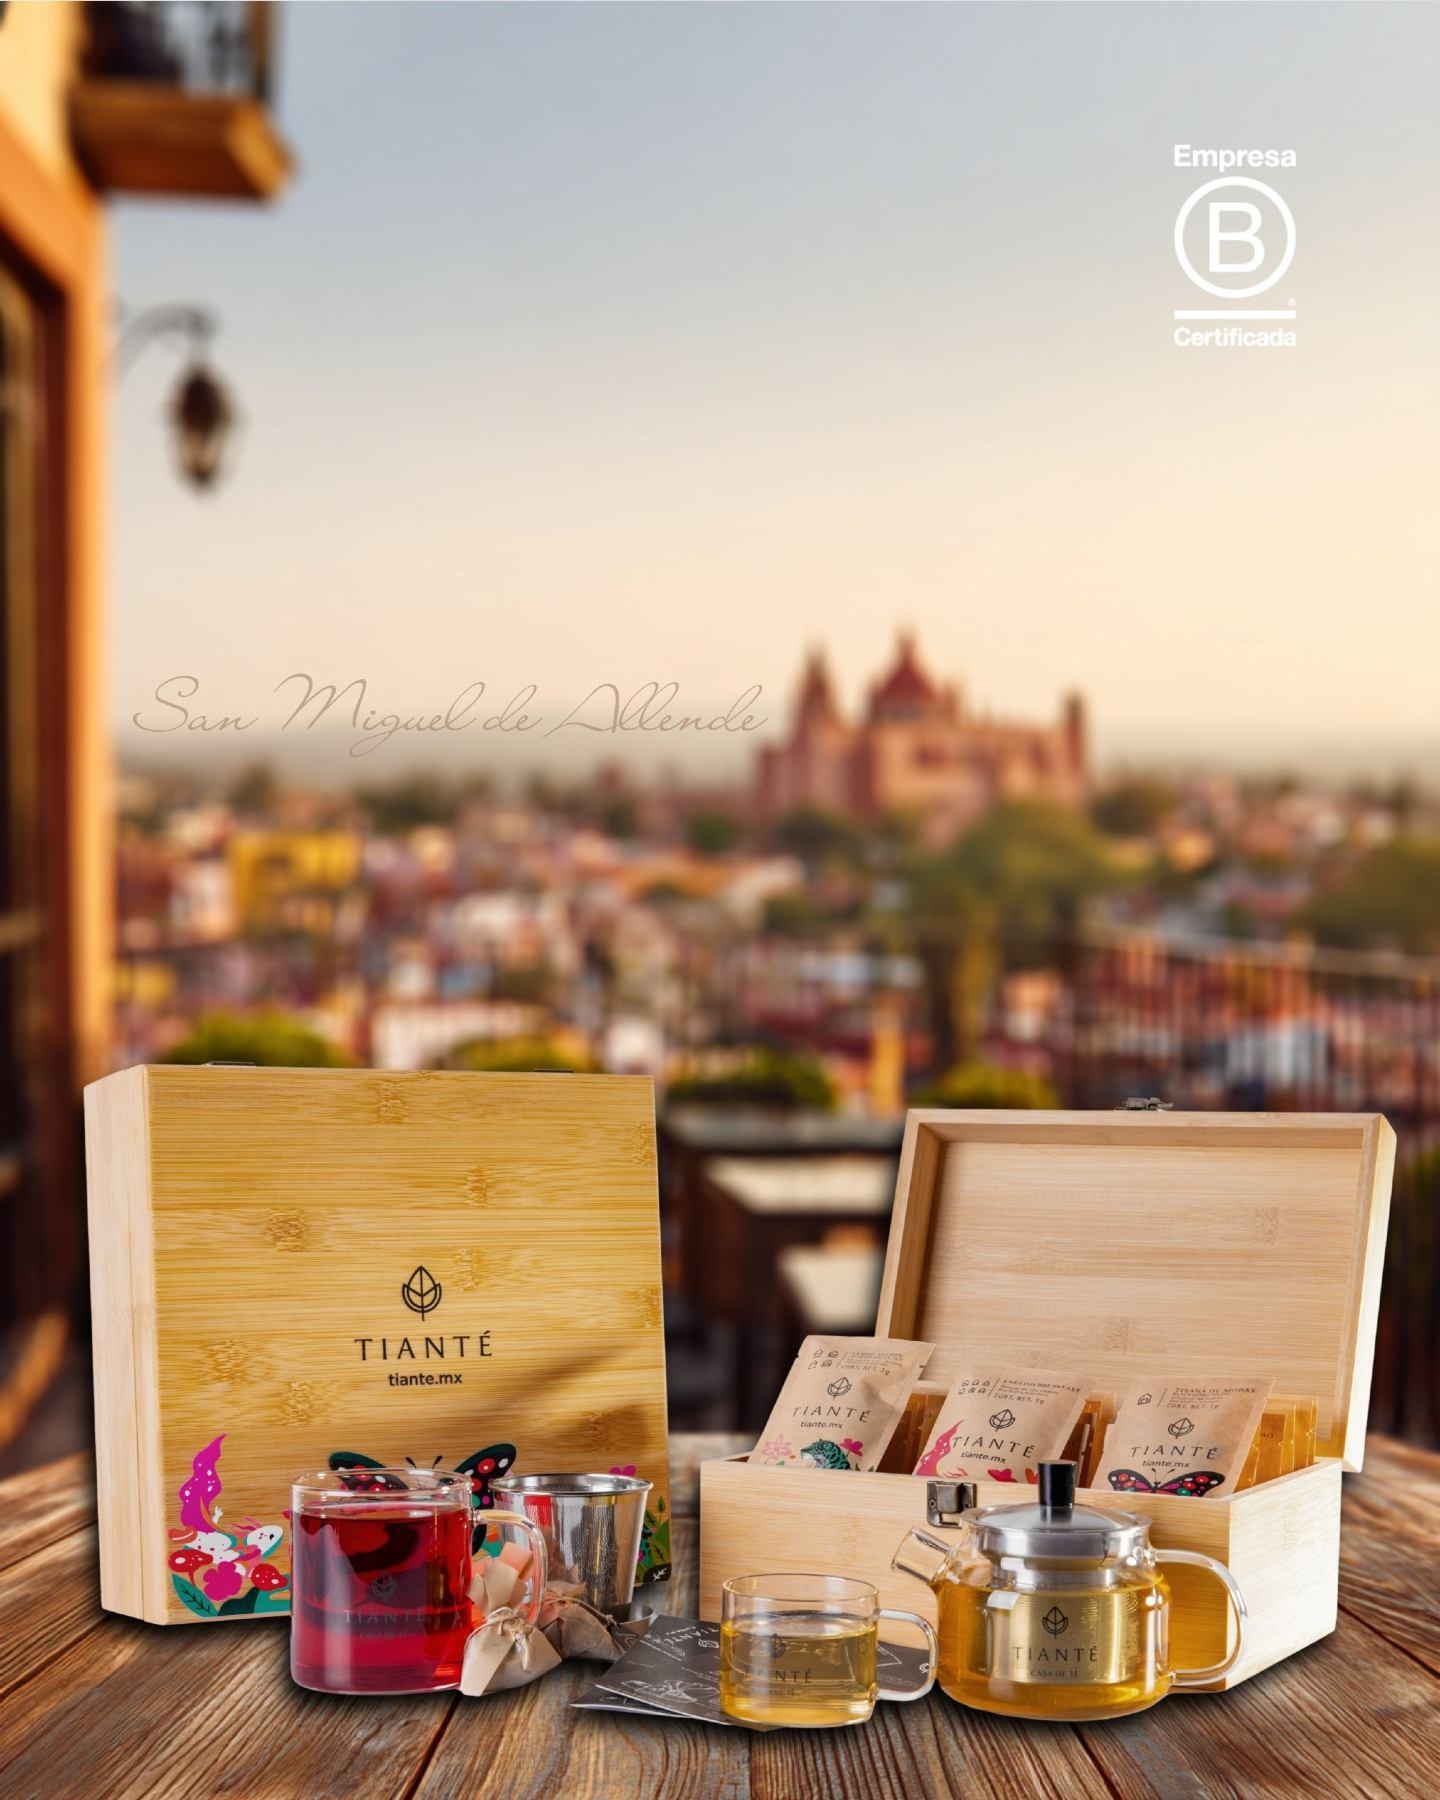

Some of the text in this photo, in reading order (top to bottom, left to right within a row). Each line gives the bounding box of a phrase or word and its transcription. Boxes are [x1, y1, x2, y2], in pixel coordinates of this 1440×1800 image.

[354, 1330, 492, 1361] TIANTÉ
[388, 1372, 463, 1387] tiante.mx
[1003, 1379, 1037, 1387] ENGLISH
[1037, 1382, 1081, 1394] BREAKFAST
[792, 1405, 872, 1423] TIANTÉ
[800, 1420, 844, 1430] tiante.mx
[952, 1436, 1036, 1459] TIANTÉ
[1130, 1445, 1218, 1460] TIANTÉ
[961, 1451, 1007, 1464] tiante.mx
[1142, 1459, 1190, 1468] tiante.mx
[1012, 1645, 1098, 1662] TIANTÉ
[1030, 1670, 1053, 1678] CASA
[1055, 1670, 1065, 1678] DE
